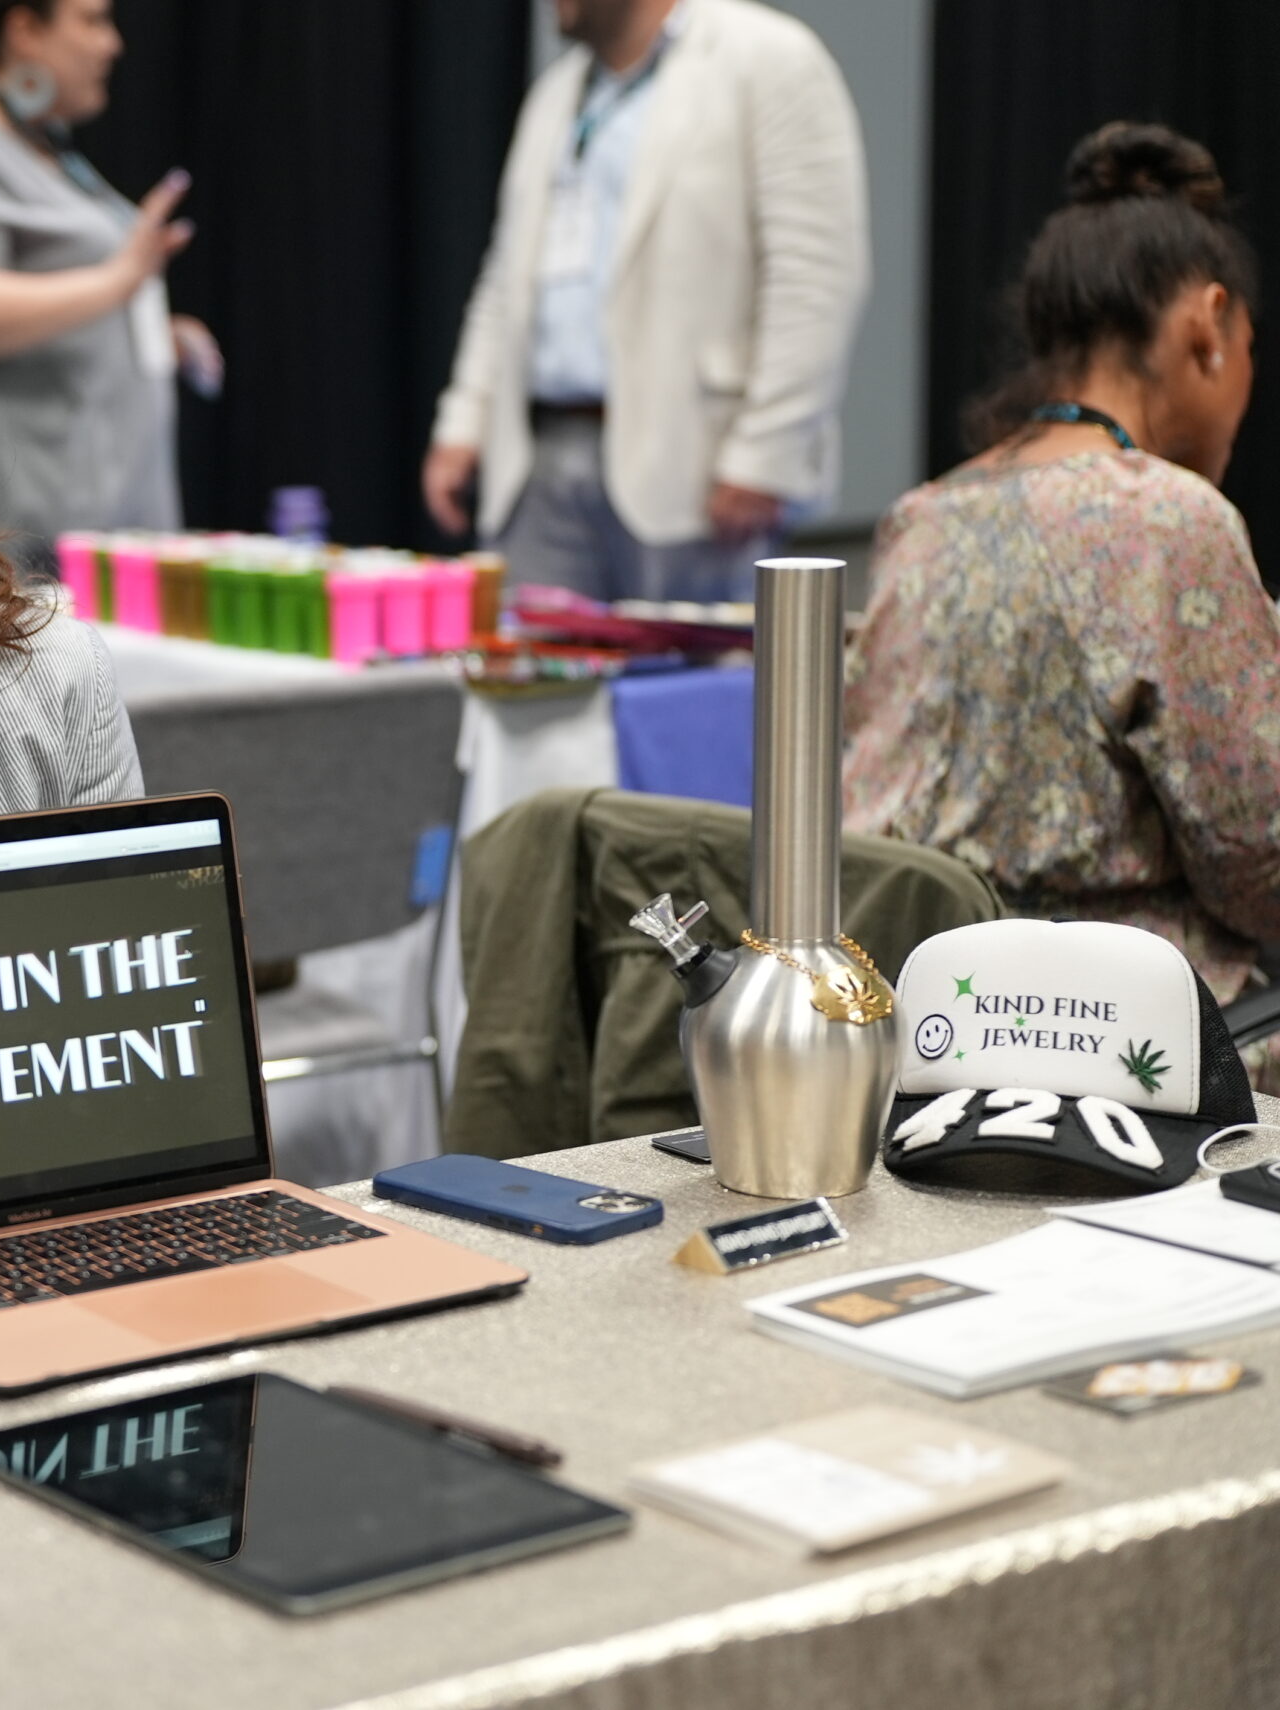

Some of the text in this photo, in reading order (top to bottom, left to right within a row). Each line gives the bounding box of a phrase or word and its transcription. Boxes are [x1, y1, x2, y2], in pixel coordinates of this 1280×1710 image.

[68, 928, 199, 999] THE
[973, 994, 1119, 1022] KIND FINE
[979, 1027, 1107, 1055] JEWELRY
